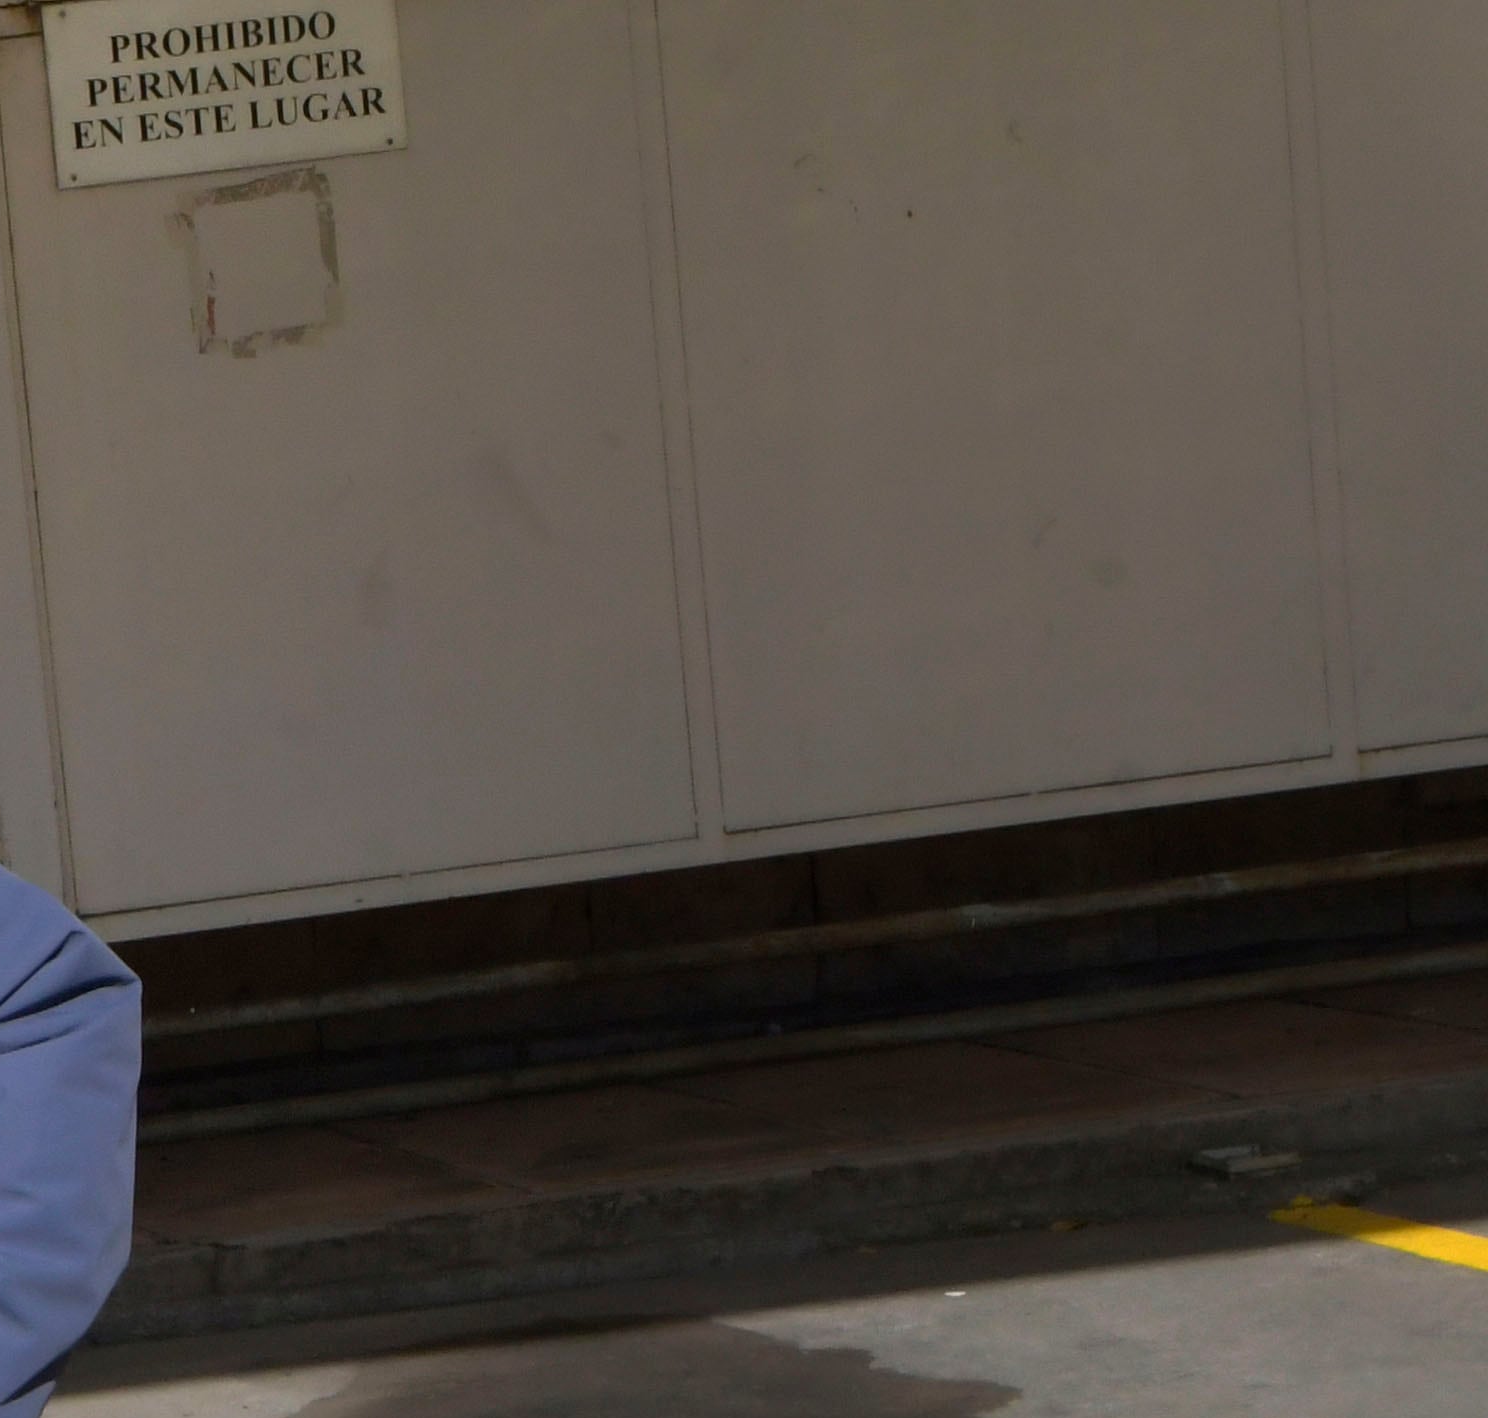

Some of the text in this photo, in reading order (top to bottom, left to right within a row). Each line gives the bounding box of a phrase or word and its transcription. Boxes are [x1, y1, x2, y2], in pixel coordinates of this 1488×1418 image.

[110, 10, 336, 64] PROHIBIDO
[87, 48, 366, 107] PERMANECER
[73, 86, 387, 150] EN ESTE LUGAR
